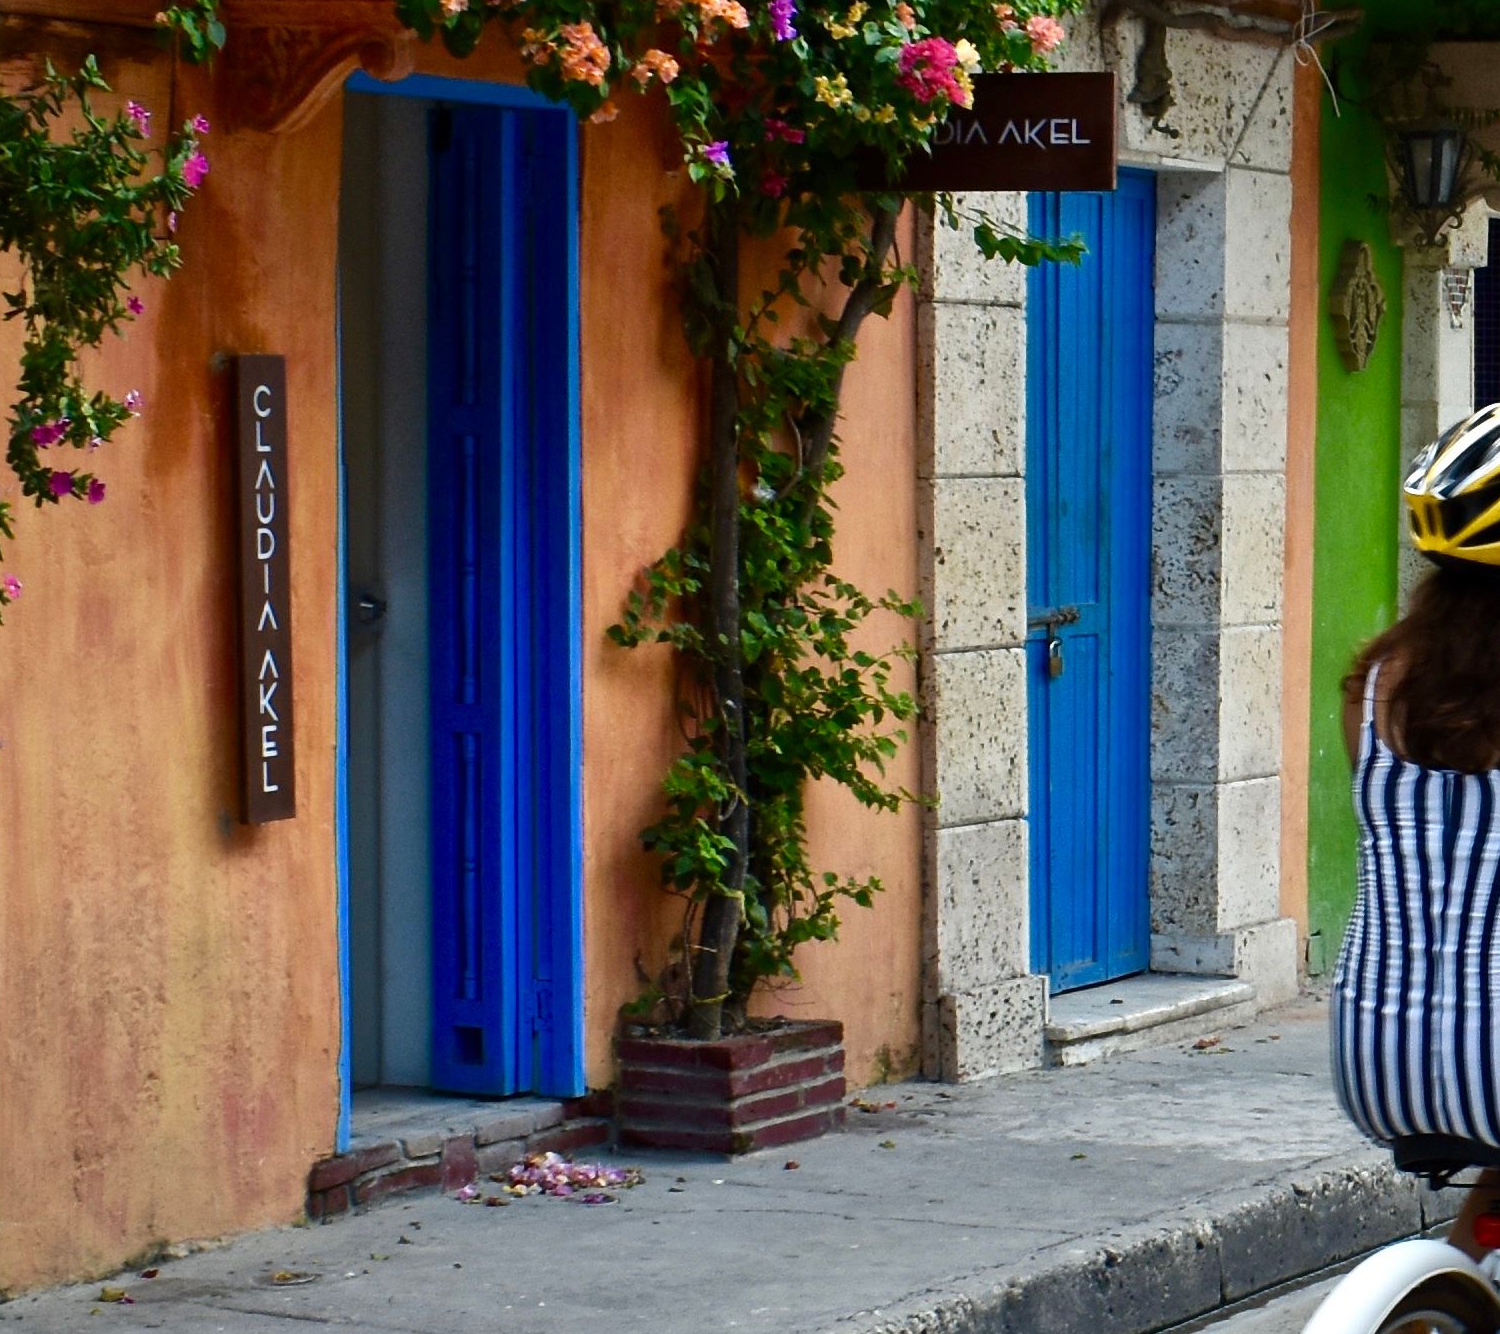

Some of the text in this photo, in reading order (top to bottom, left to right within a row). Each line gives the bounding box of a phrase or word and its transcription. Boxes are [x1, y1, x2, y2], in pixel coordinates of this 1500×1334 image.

[932, 118, 1092, 150] DIA AKEL
[251, 384, 279, 793] CLAUDIA AKEL
